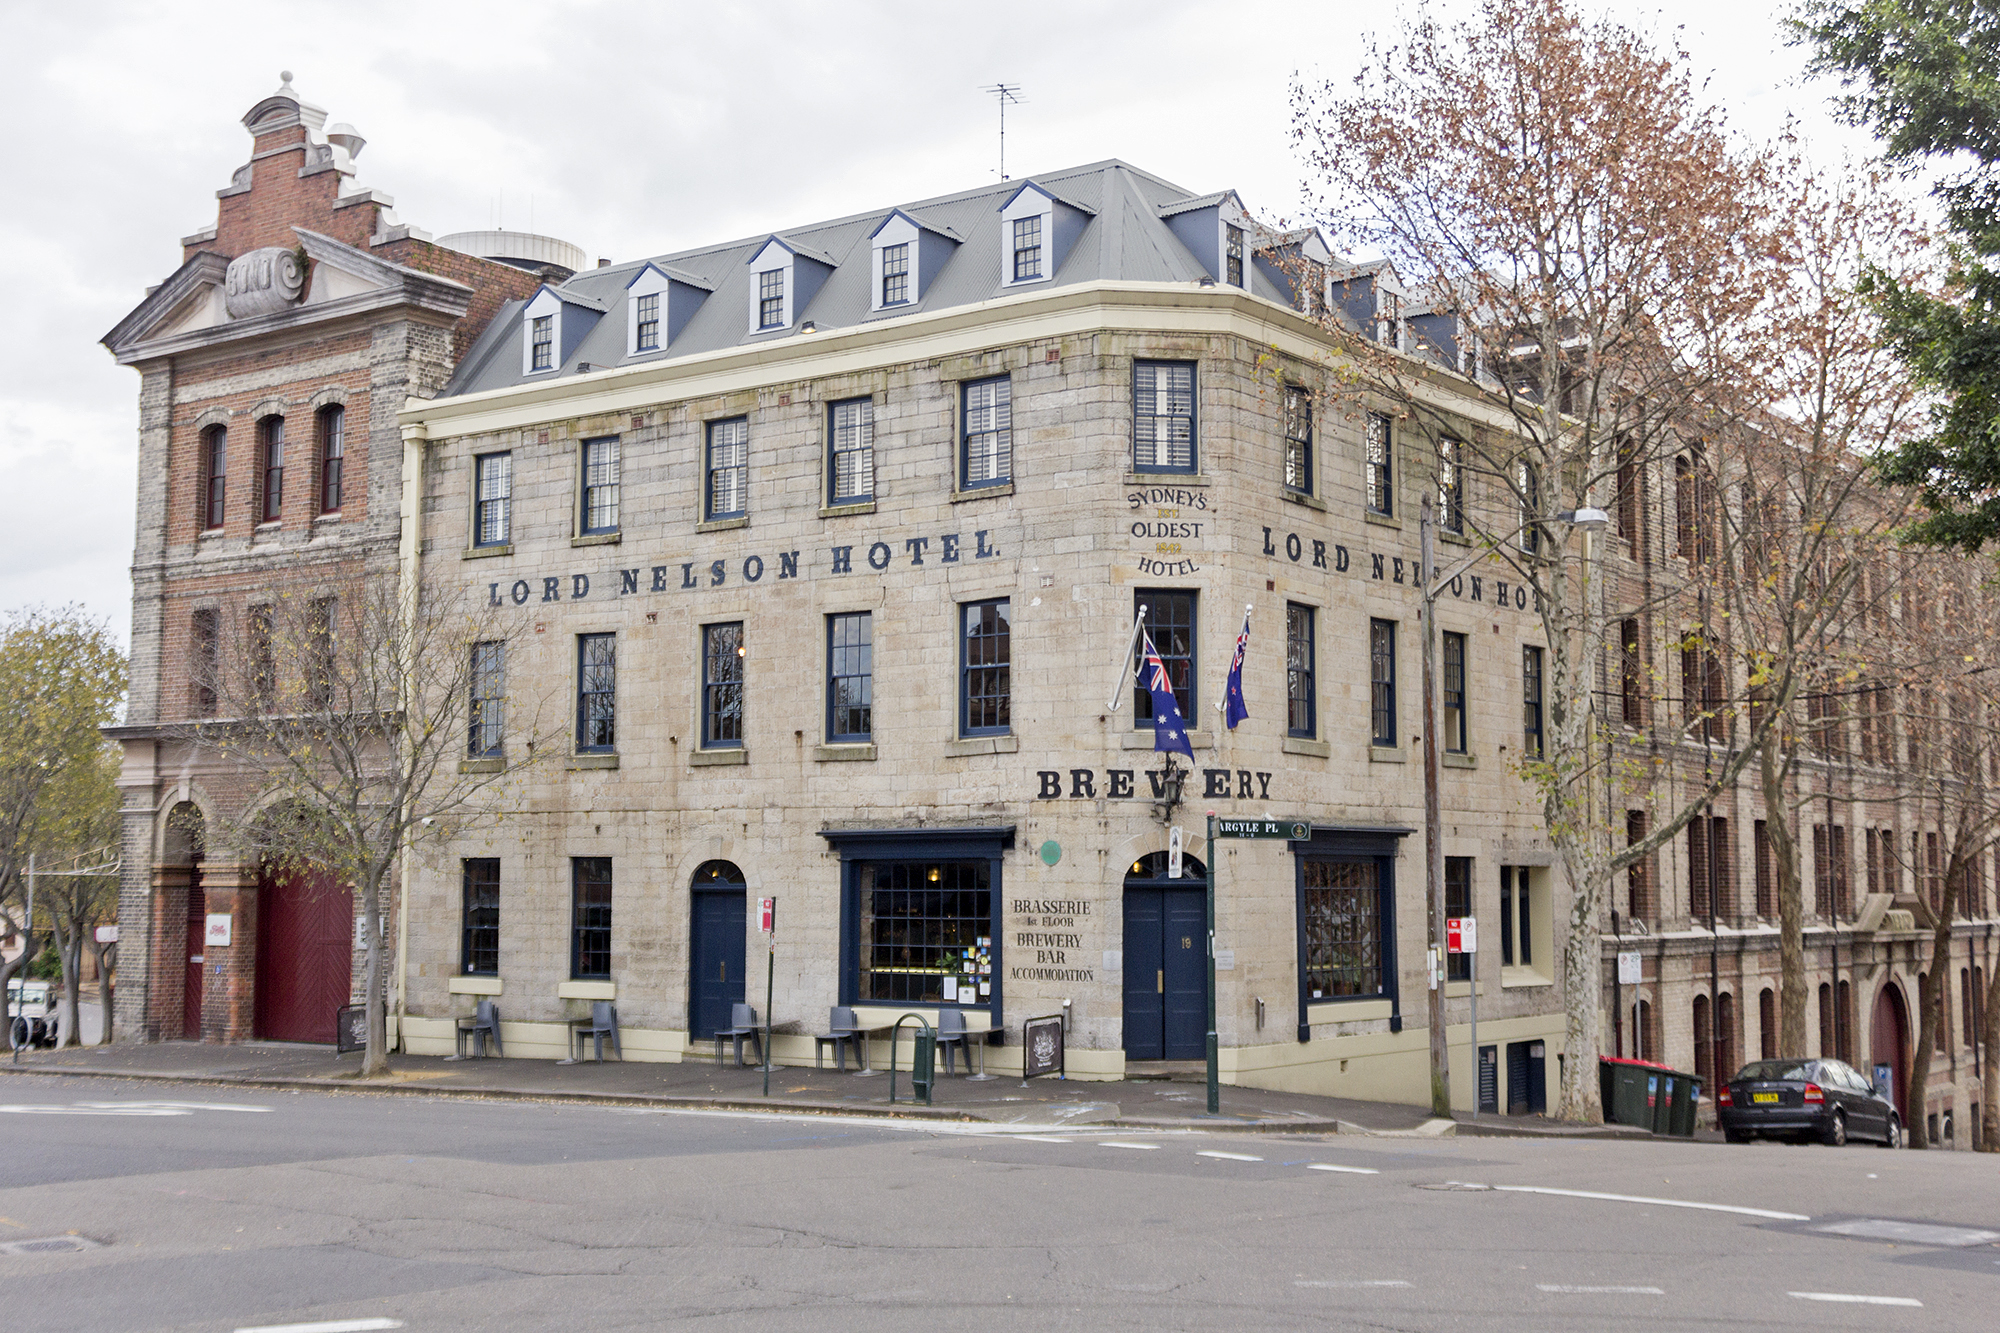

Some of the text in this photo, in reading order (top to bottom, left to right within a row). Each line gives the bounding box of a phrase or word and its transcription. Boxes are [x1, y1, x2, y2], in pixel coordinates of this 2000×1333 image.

[1127, 488, 1207, 510] SYDNEY'S
[1131, 522, 1203, 538] OLDEST
[1156, 542, 1182, 554] 1842
[1262, 526, 1350, 572] LORD
[1138, 556, 1199, 576] HOTEL
[488, 574, 590, 607] LORD
[620, 551, 799, 595] NELSON
[1037, 769, 1272, 799] BREWERY
[1265, 822, 1278, 833] PL
[1013, 900, 1091, 915] BRASSERIE
[1042, 917, 1074, 927] FLOOR
[1017, 933, 1082, 948] BREWERY
[1181, 938, 1191, 949] 19
[1036, 950, 1066, 964] BAR
[1010, 967, 1094, 982] ACCOMMODATION
